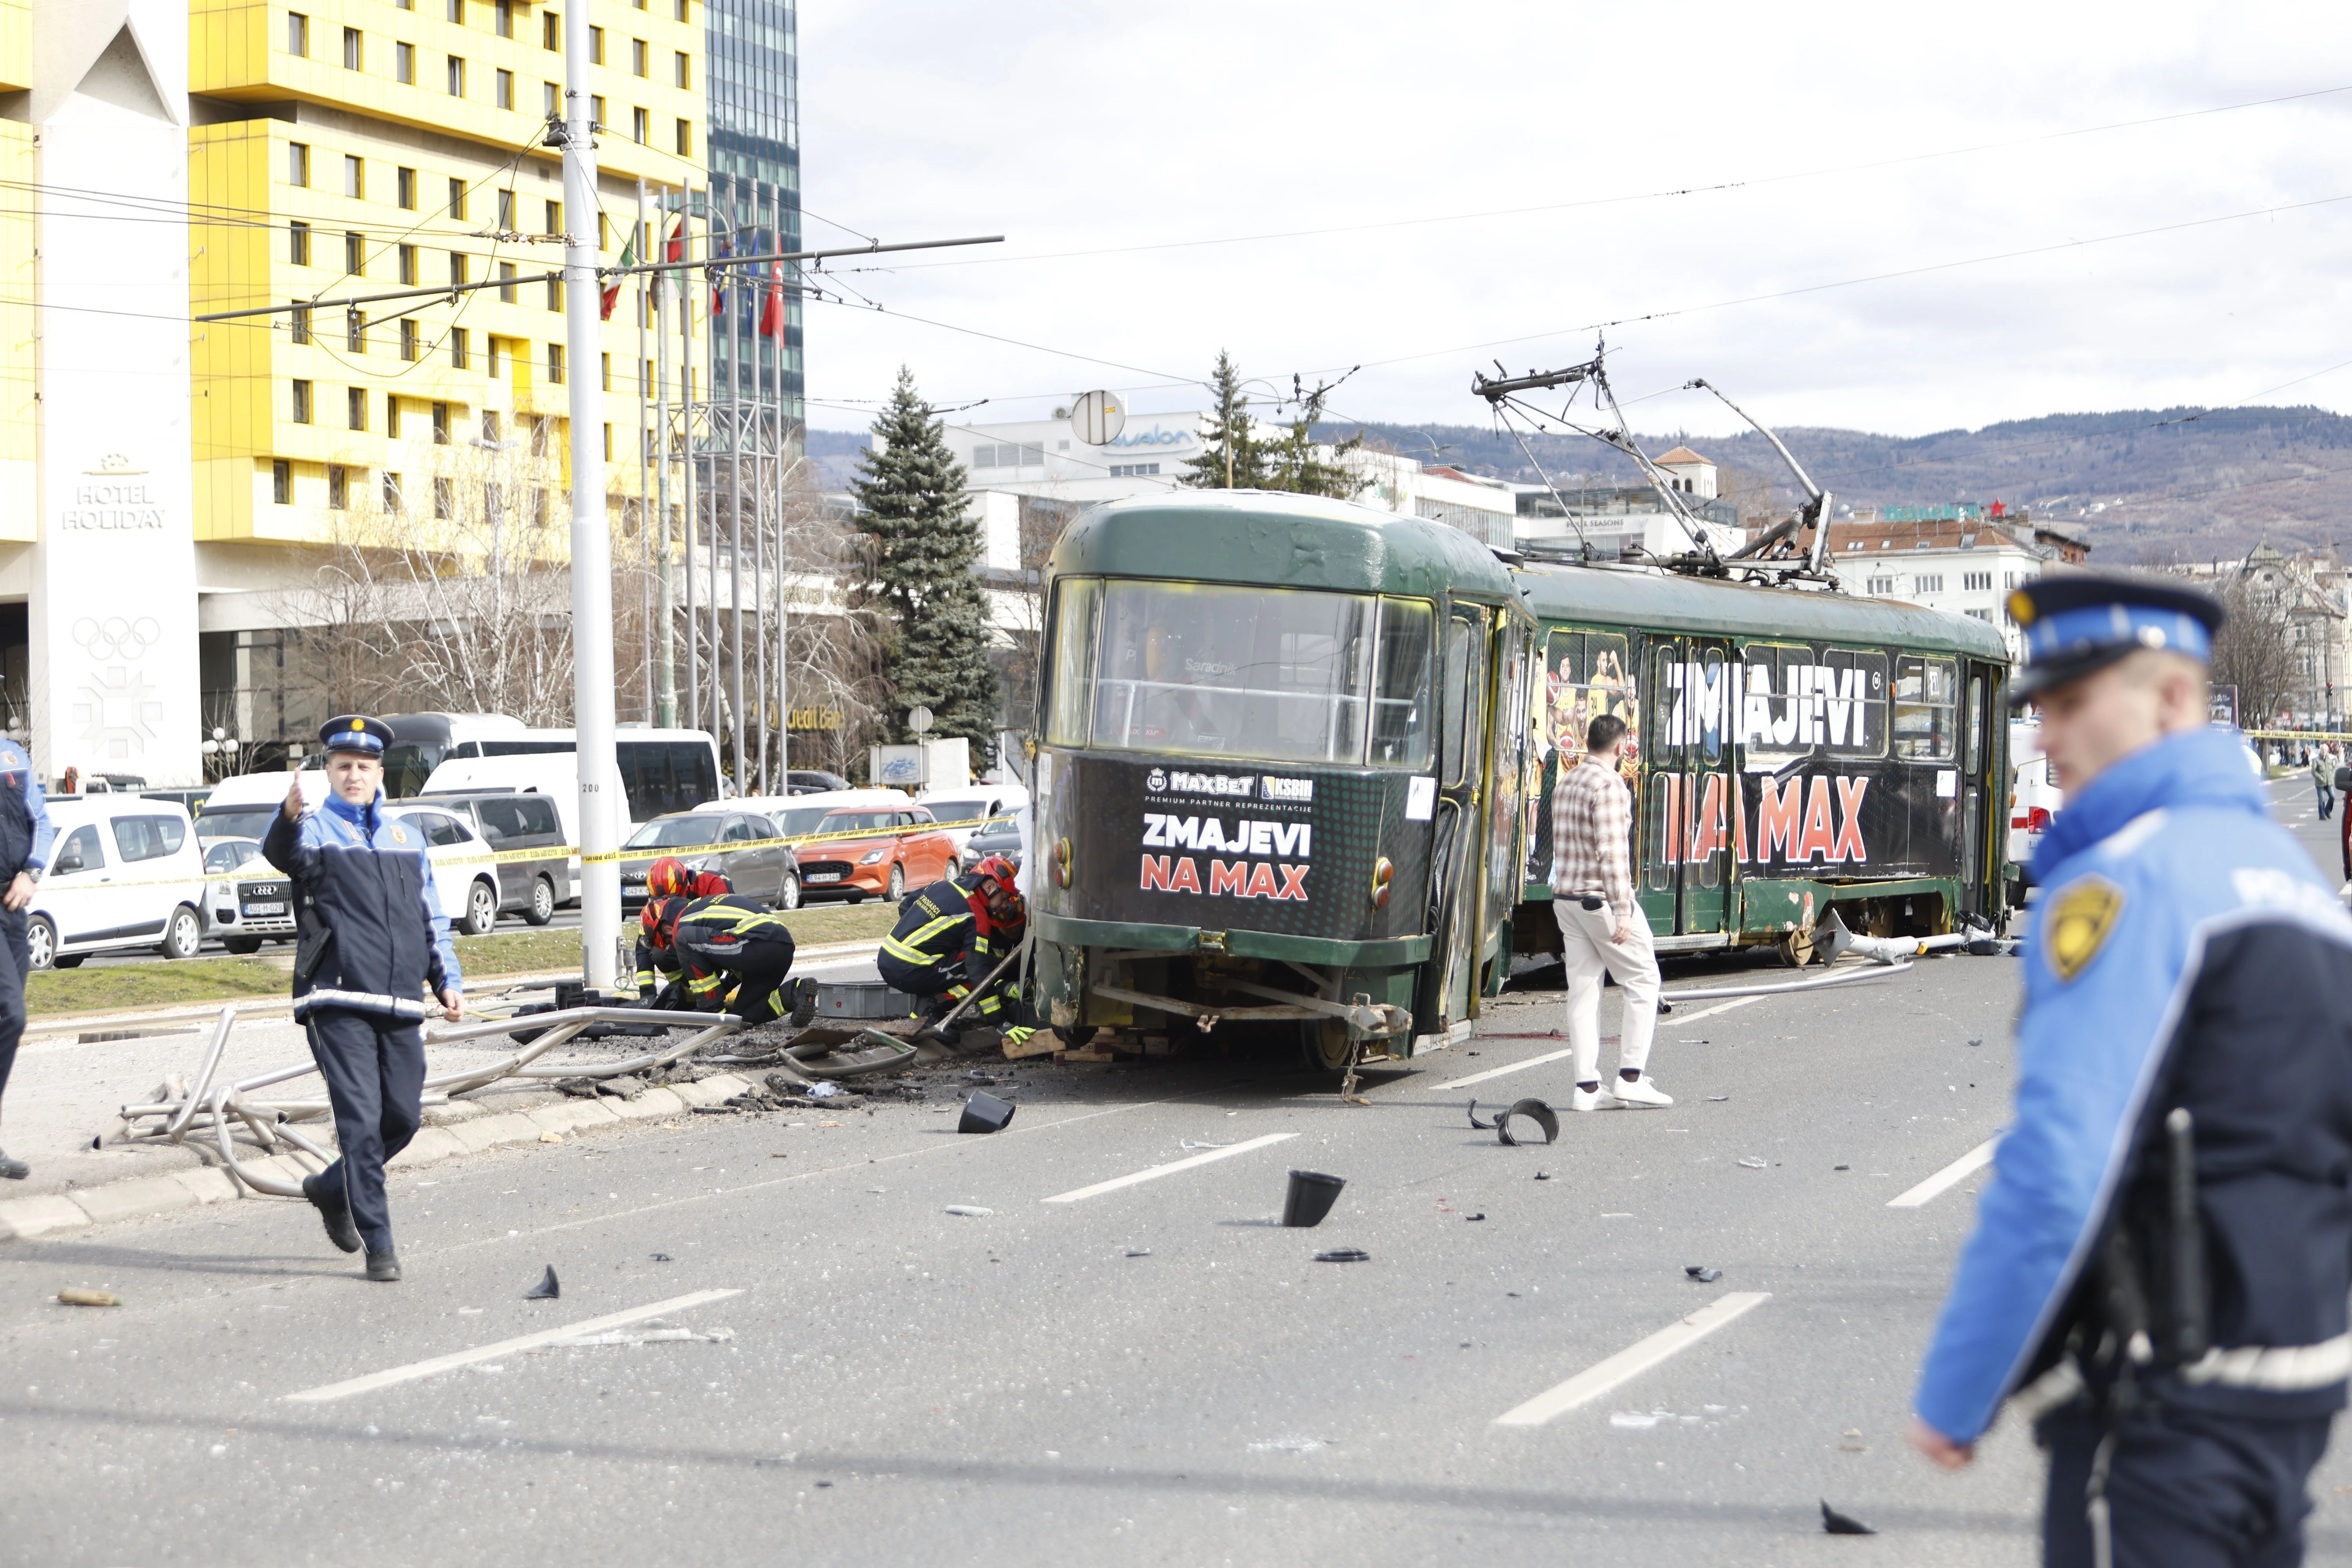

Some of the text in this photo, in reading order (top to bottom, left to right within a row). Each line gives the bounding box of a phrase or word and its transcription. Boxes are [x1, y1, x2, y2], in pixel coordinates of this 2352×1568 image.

[77, 485, 155, 505] HOTEL
[62, 509, 165, 530] HOLIDAY
[1590, 518, 1624, 526] SEASONS
[1185, 658, 1236, 676] Saradnik
[1665, 662, 1866, 746] ZMAJEVI
[583, 784, 599, 792] 200
[1275, 778, 1313, 797] KSBIH
[1145, 795, 1312, 813] PREMIUM PARTNER REPREZENTACIJE
[1757, 775, 1869, 863] MAX
[1142, 813, 1311, 857] ZMAJEVI
[604, 852, 616, 860] STOP
[1140, 853, 1310, 900] NA MAX
[249, 903, 283, 913] A01-M-028
[919, 895, 940, 915] TROGASCI
